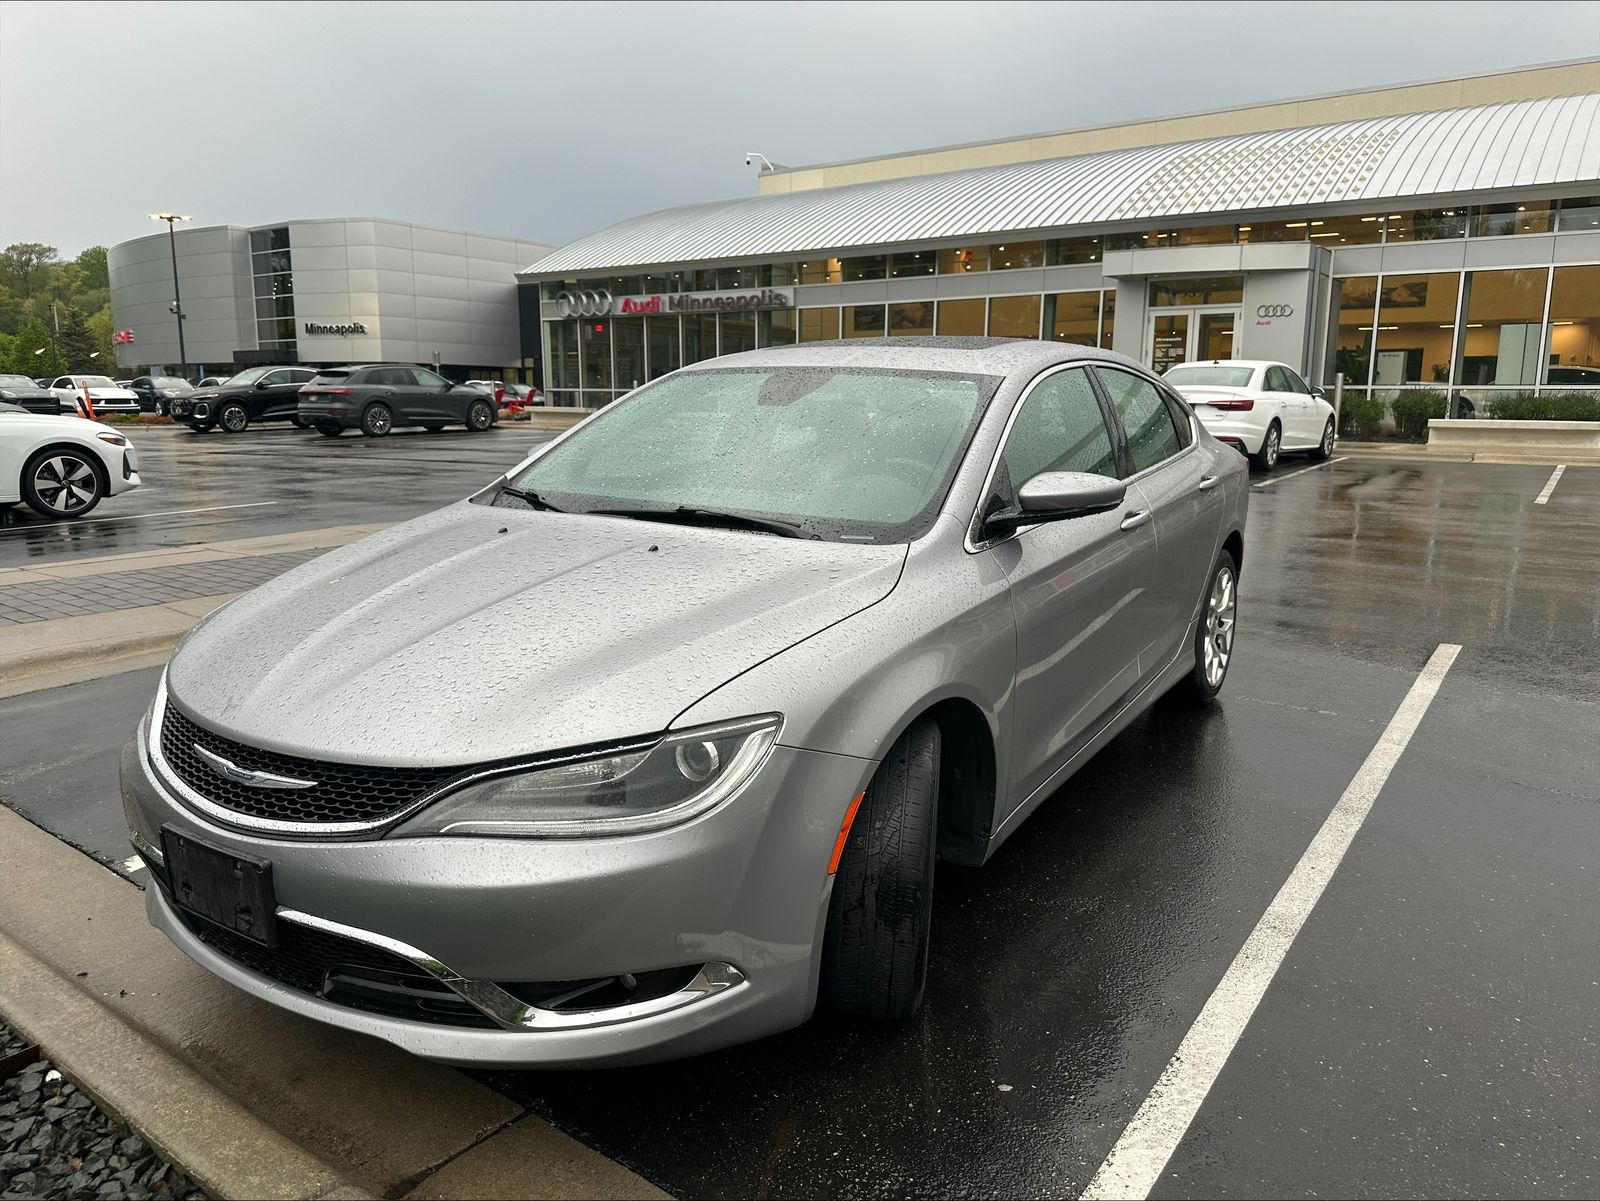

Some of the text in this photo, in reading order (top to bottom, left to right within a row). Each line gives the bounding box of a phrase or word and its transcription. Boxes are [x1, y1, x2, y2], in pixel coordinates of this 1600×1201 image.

[620, 289, 787, 314] Audi Minneapolis
[305, 322, 367, 336] Minneapolis
